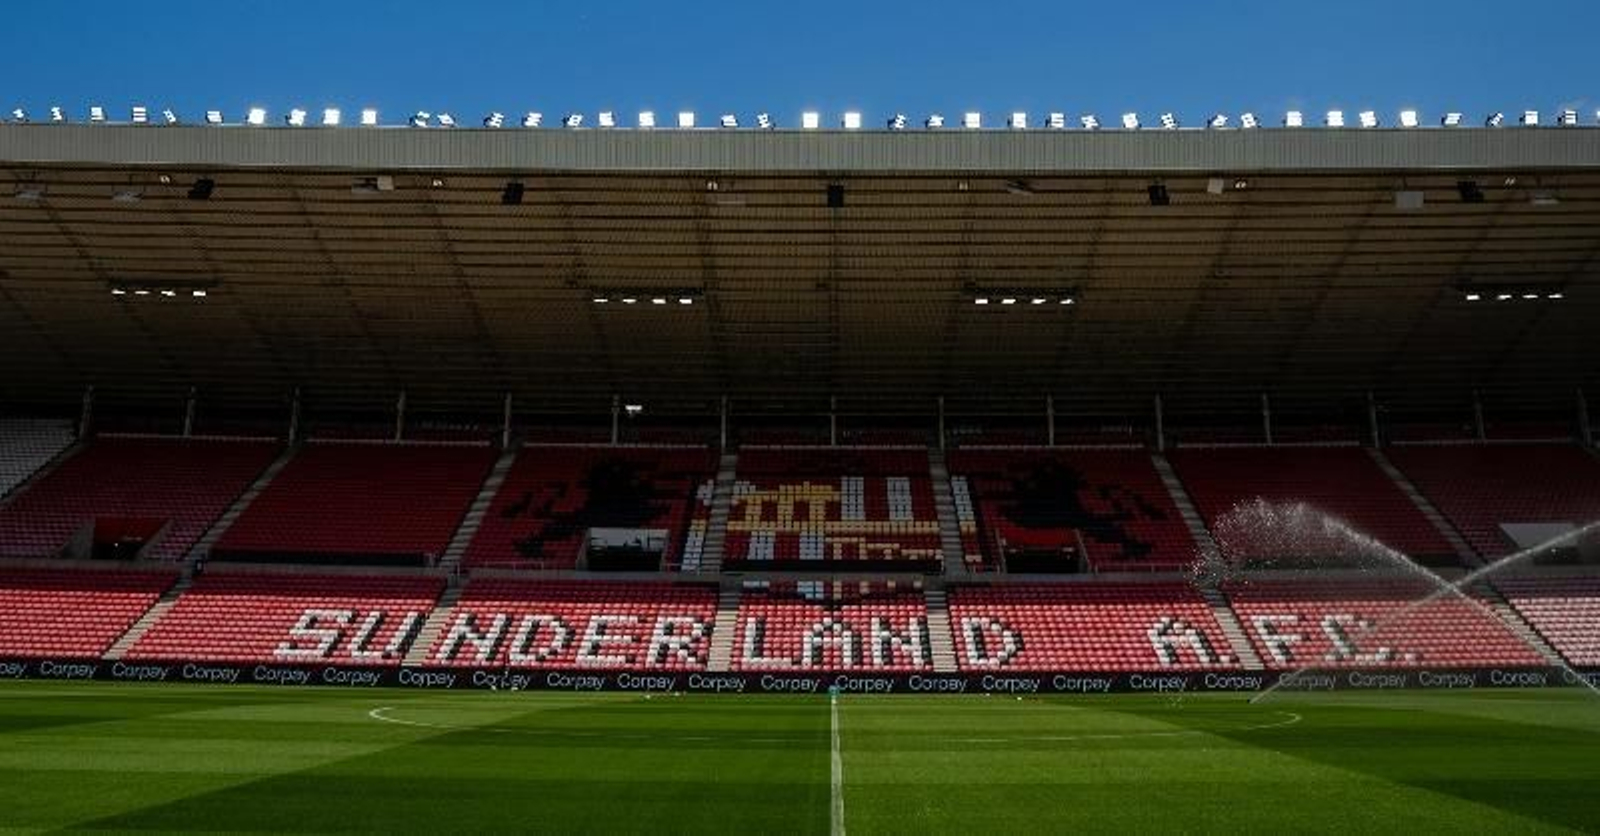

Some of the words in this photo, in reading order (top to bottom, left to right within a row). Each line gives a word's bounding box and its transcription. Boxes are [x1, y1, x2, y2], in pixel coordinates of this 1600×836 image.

[273, 608, 1024, 666] SUNDERLAND
[41, 661, 96, 680] Corpay
[112, 662, 169, 680] Corpay
[182, 664, 240, 681] Corpay
[254, 665, 310, 683] Corpay
[323, 667, 381, 685] Corpay
[399, 668, 456, 687] Corpay
[547, 672, 605, 689] Corpay
[617, 673, 676, 690] Corpay
[688, 674, 746, 691] Corpay
[760, 674, 820, 691] Corpay
[835, 674, 895, 691] Corpay
[908, 675, 968, 691] Corpay
[982, 674, 1041, 691] Corpay
[1053, 674, 1112, 692] Corpay
[1129, 674, 1188, 691] Corpay
[1205, 673, 1263, 689] Corpay
[1350, 671, 1407, 687] Corpay
[1419, 671, 1476, 688] Corpay
[1490, 669, 1549, 688] Corpay
